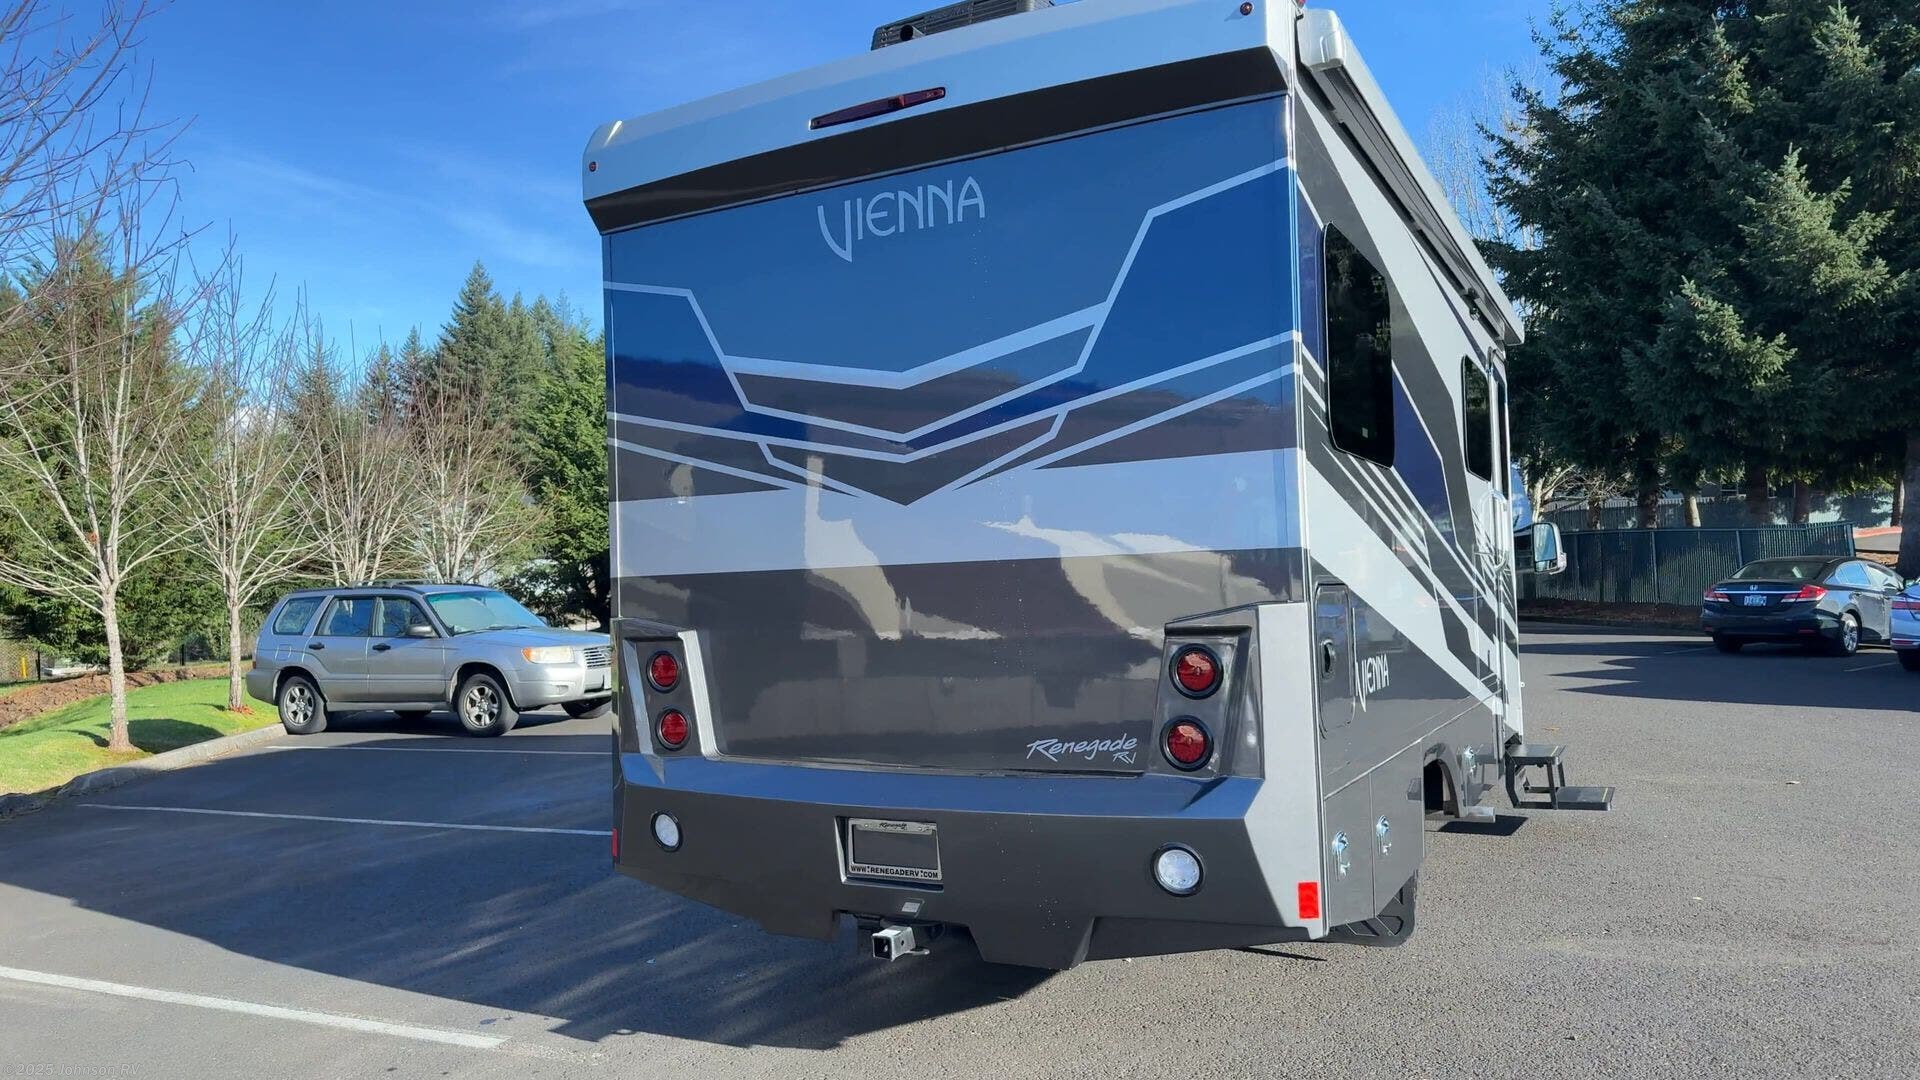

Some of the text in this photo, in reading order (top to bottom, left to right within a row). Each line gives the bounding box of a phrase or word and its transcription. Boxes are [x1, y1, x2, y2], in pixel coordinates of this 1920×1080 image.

[817, 176, 985, 263] VIENNA
[1355, 653, 1390, 712] VIENNA
[1026, 733, 1138, 762] Renegade
[1113, 751, 1137, 764] RV
